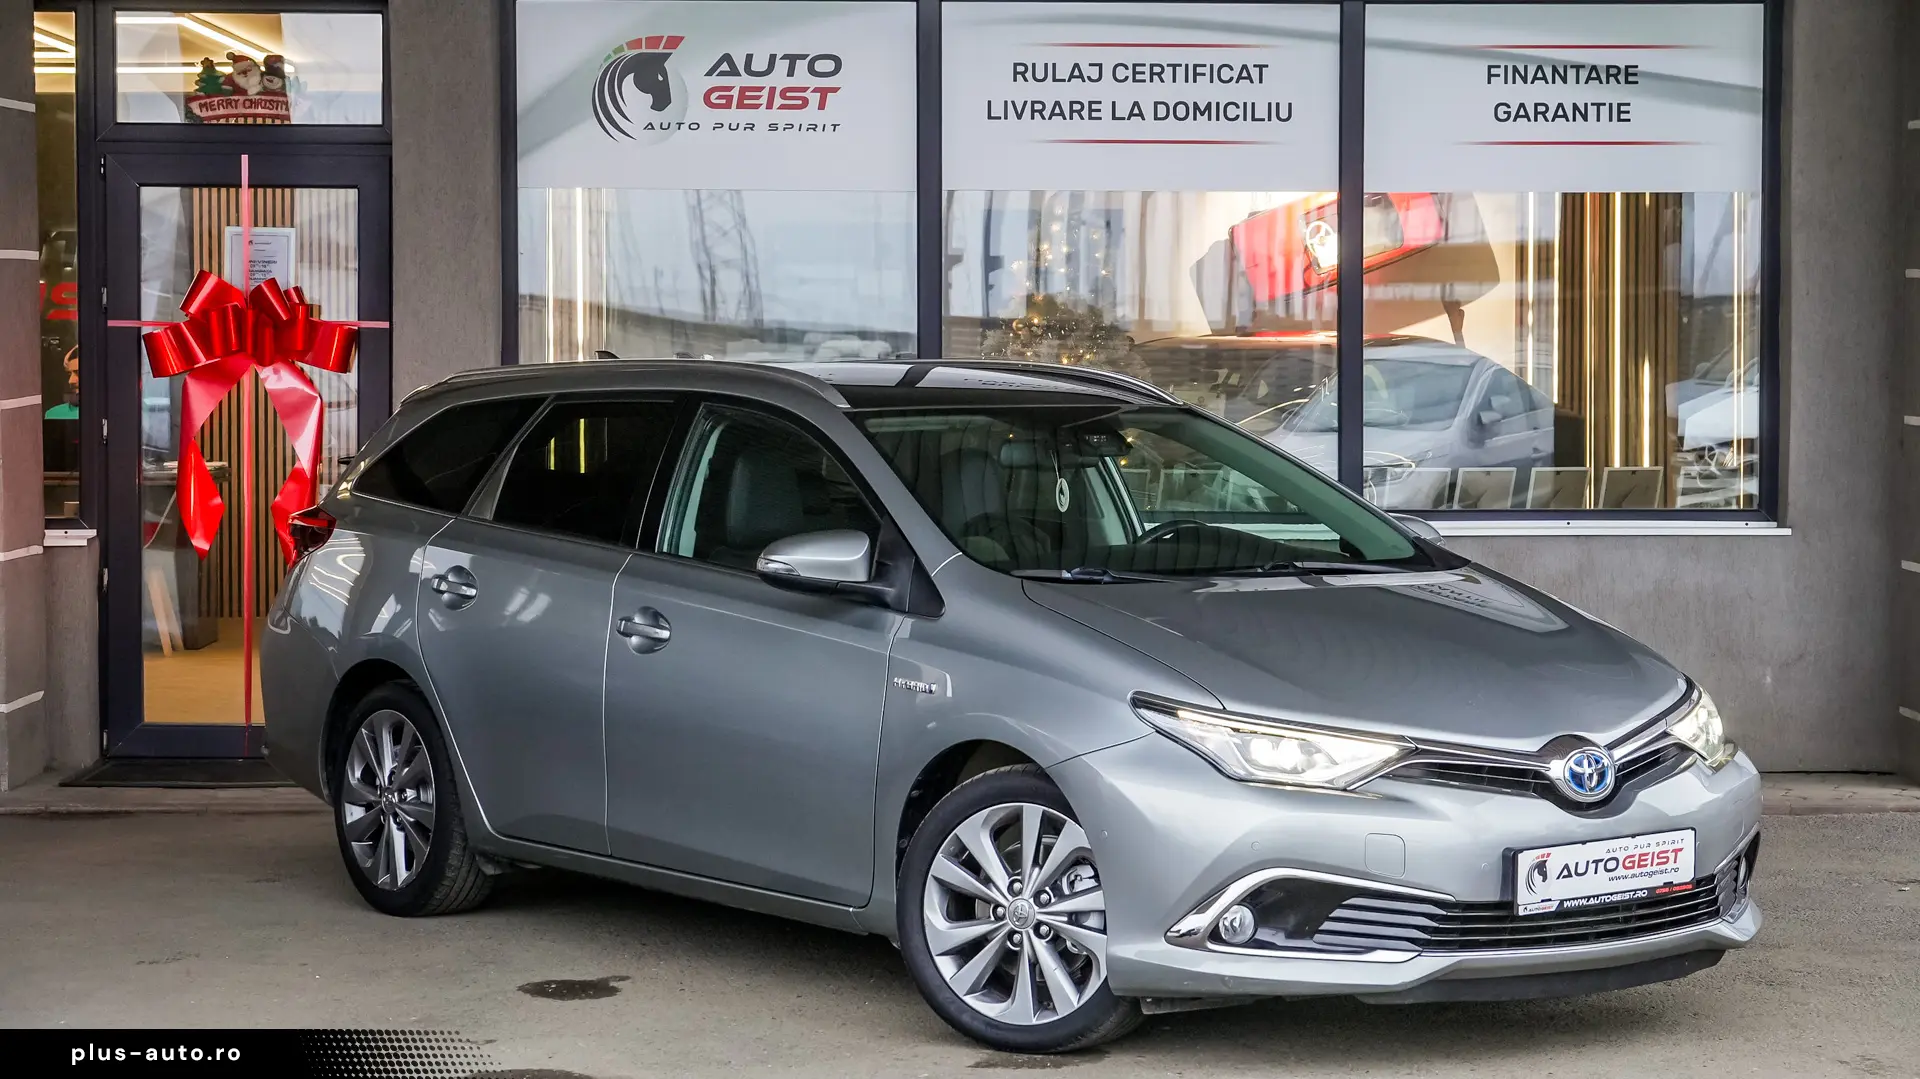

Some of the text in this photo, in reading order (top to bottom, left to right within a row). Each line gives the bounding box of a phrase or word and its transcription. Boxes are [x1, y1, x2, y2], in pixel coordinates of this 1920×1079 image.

[703, 53, 843, 78] AUTO
[1012, 62, 1269, 85] RULAJ CERTIFICAT
[1486, 64, 1640, 85] FINANTARE
[198, 98, 241, 113] MERRY
[702, 86, 842, 111] GEIST
[986, 100, 1294, 123] LIVRARE LA DOMICILIU
[1493, 102, 1632, 123] GARANTIE
[642, 121, 842, 133] AUTO PUR SPIRIT
[1605, 838, 1685, 854] AUTO PUR SPIRIT
[1608, 866, 1680, 882] www.autogeist.ro
[1563, 889, 1648, 909] WWW.AUTOGEIST.RO
